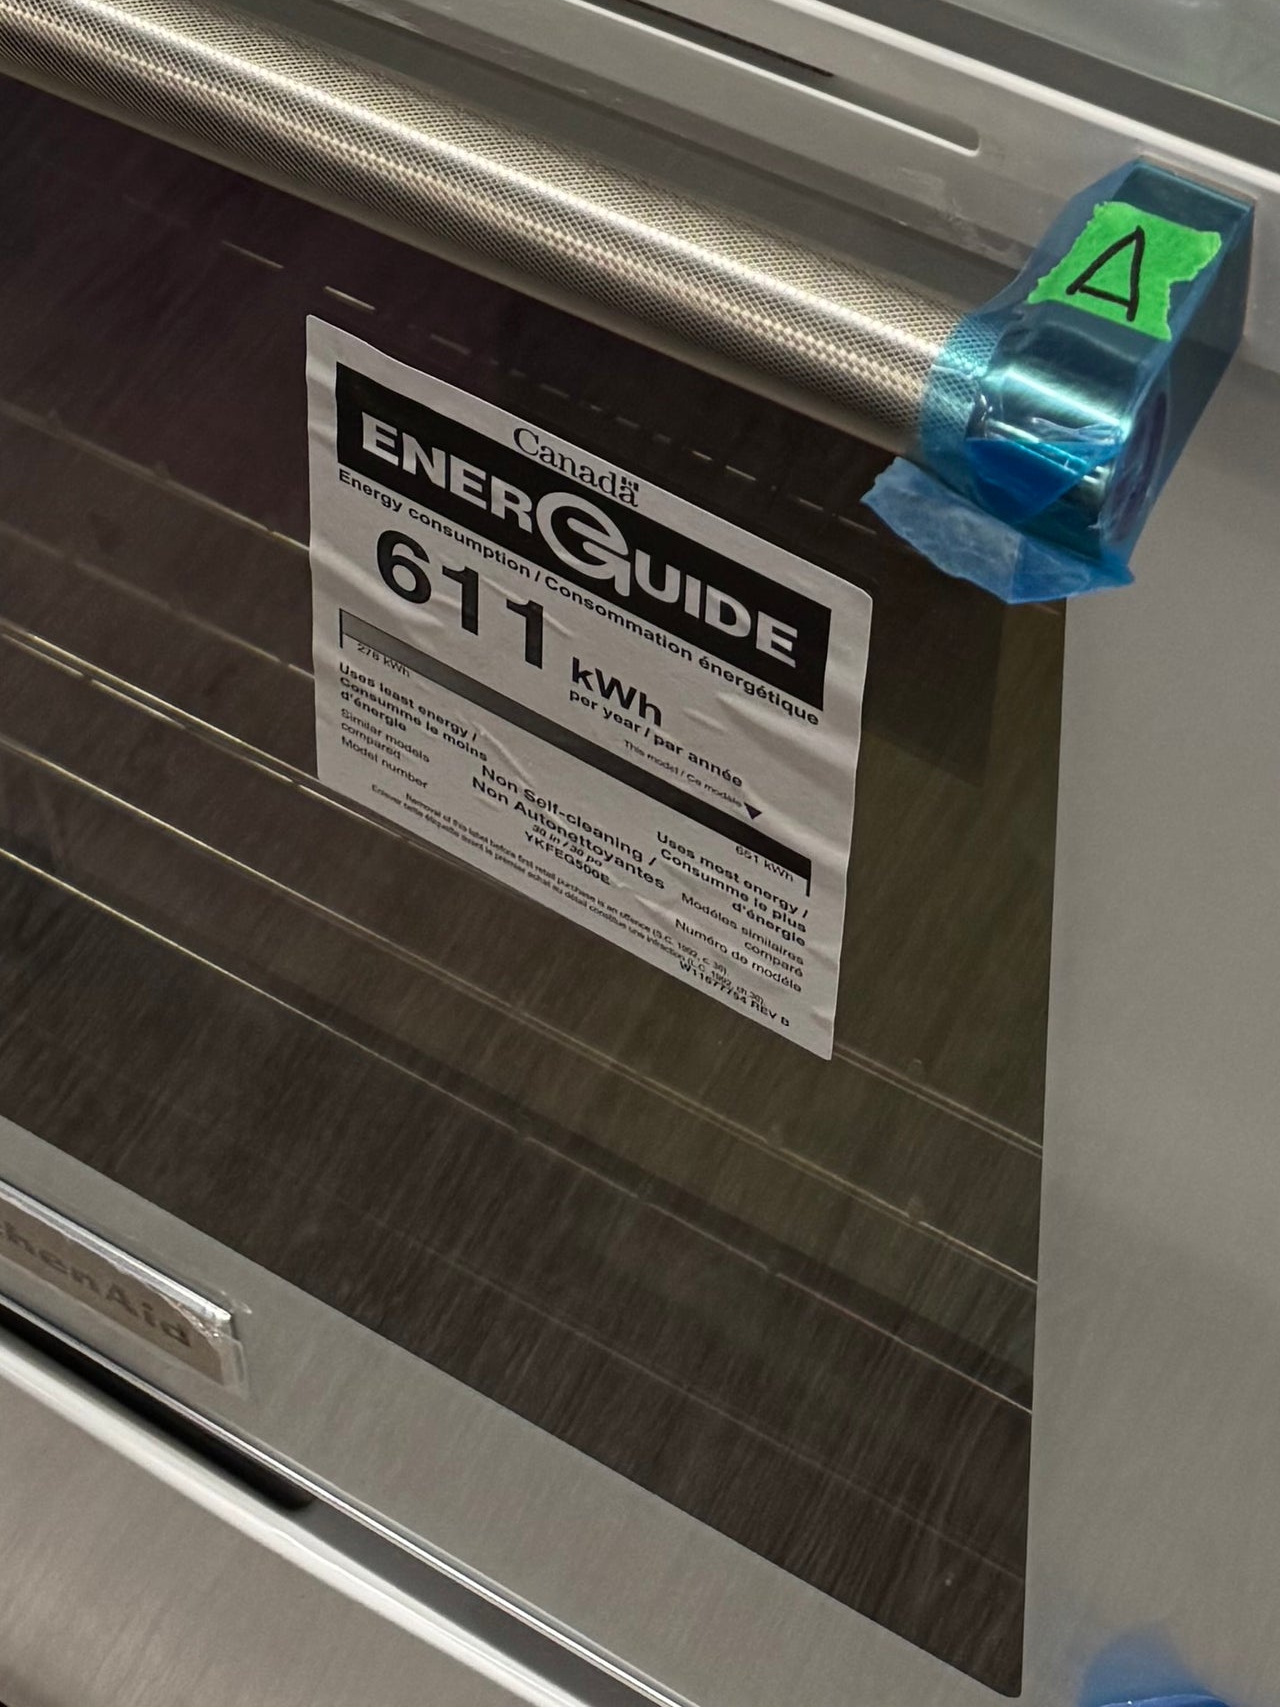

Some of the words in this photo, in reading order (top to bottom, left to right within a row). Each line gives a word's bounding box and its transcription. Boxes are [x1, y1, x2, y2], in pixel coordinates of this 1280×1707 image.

[1065, 224, 1145, 322] A
[513, 426, 639, 508] Canada
[361, 410, 798, 669] ENERGUIDE
[339, 469, 403, 514] Energy
[408, 505, 531, 580] consumption
[544, 576, 693, 661] Consommation
[699, 654, 820, 726] énergétique
[376, 529, 544, 669] 611
[571, 656, 662, 729] kWh
[339, 663, 376, 688] Uses
[379, 679, 415, 709] least
[418, 702, 468, 737] energy
[340, 690, 408, 734] d'énergie
[341, 708, 383, 737] Similar
[385, 734, 431, 765] models
[341, 723, 402, 761] compared
[341, 735, 379, 766] Model
[381, 757, 429, 789] number
[425, 719, 439, 736] le
[442, 731, 488, 763] moins
[569, 690, 598, 711] per
[602, 707, 641, 735] year
[654, 734, 684, 756] par
[688, 751, 743, 787] année
[472, 776, 509, 806] Non
[513, 800, 665, 890] Autonettoyantes
[482, 764, 519, 793] Non
[523, 788, 644, 863] Self-cleaning
[656, 830, 696, 860] Uses
[699, 855, 741, 885] most
[743, 878, 799, 917] energy
[675, 918, 729, 955] Numéro
[731, 948, 749, 967] de
[731, 901, 807, 948] d'énergie
[741, 925, 806, 965] similaires
[753, 897, 768, 913] le
[771, 908, 808, 934] plus
